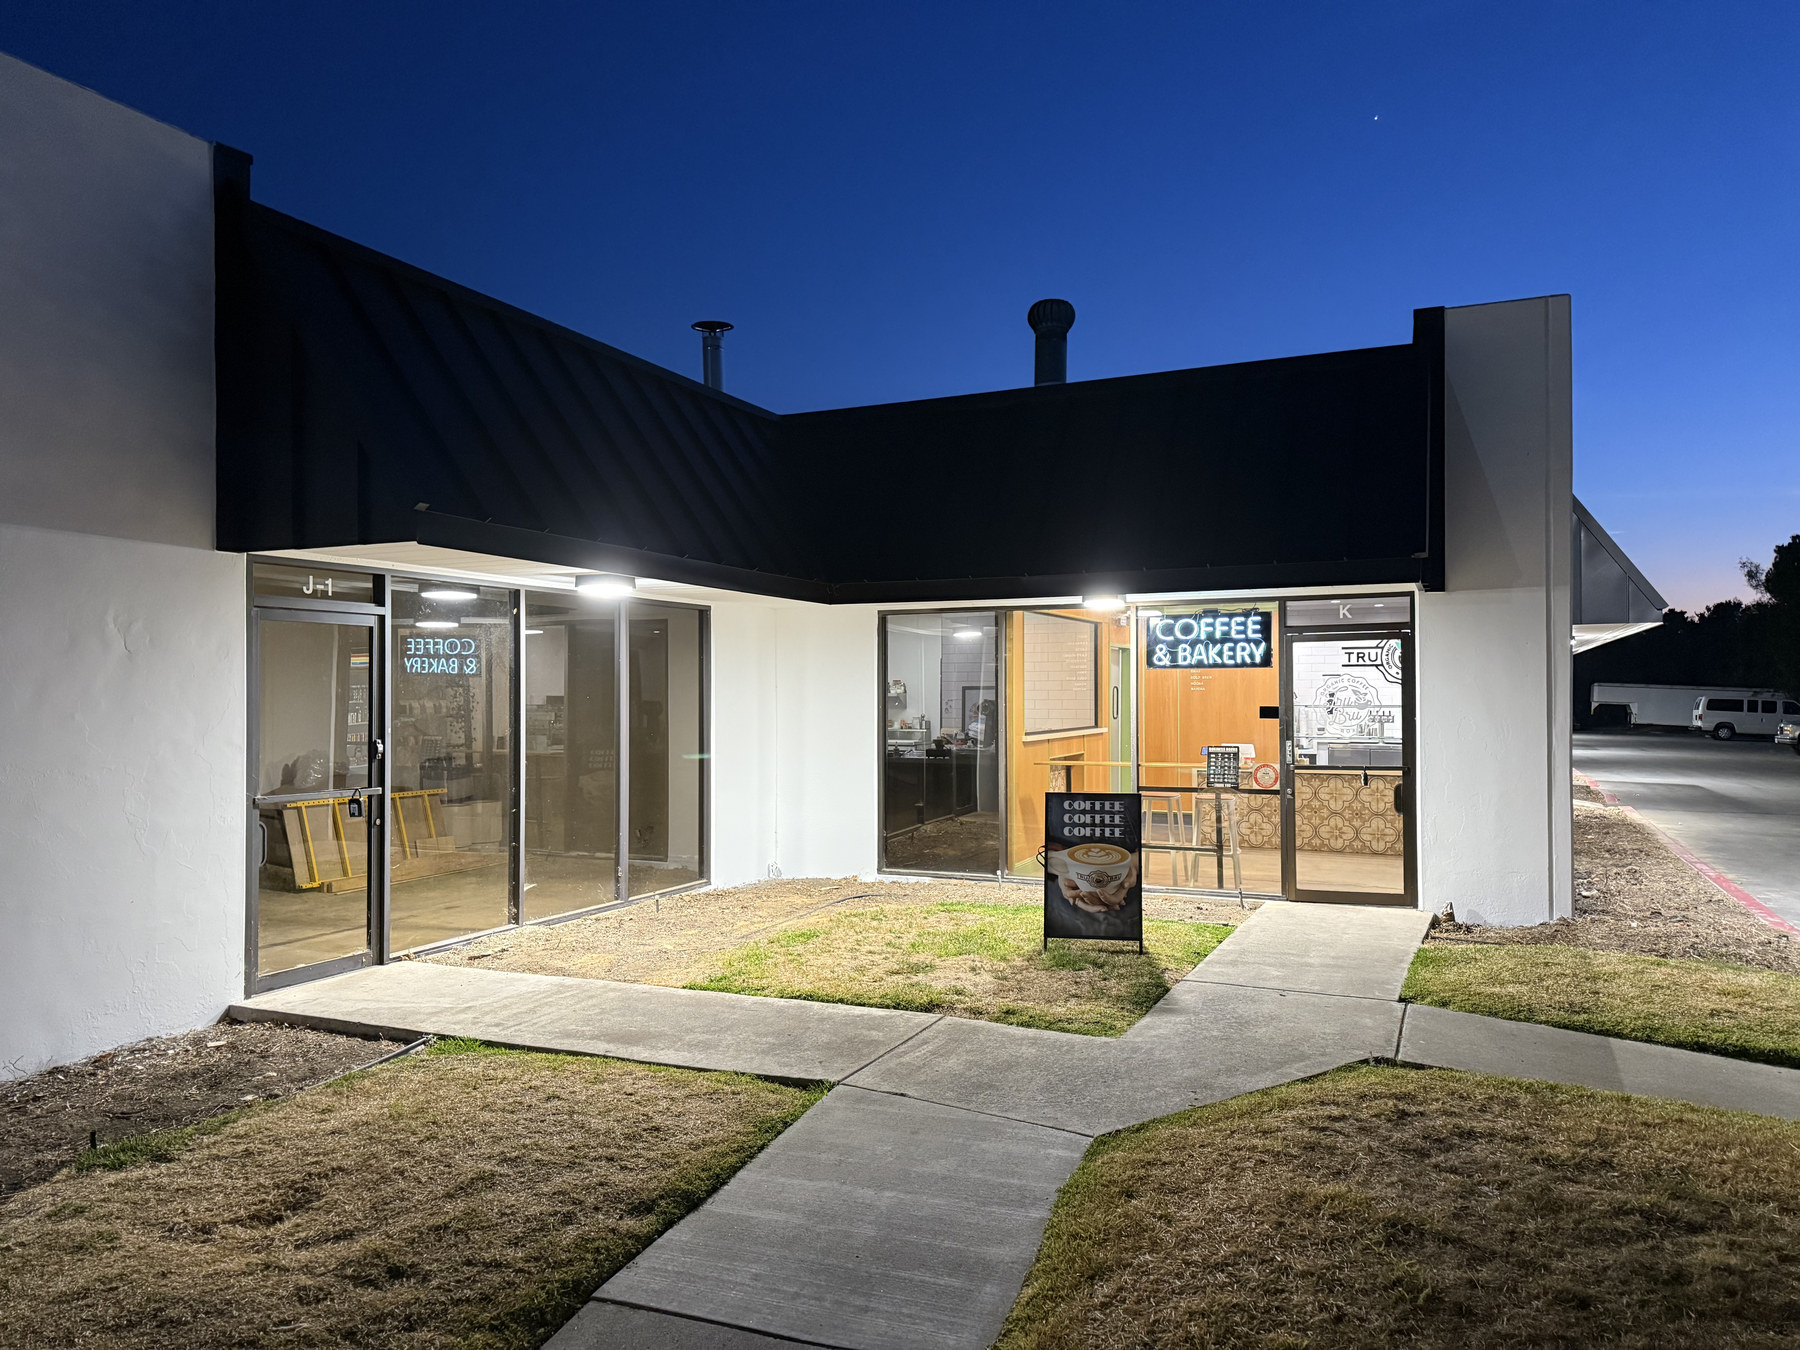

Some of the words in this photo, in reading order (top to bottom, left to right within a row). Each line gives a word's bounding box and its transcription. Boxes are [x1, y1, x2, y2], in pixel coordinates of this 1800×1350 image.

[303, 575, 332, 596] J-1
[1339, 604, 1352, 619] K
[1156, 616, 1262, 640] COFFEE
[1153, 643, 1171, 666] &
[1178, 642, 1265, 665] BAKERY
[1344, 651, 1378, 663] TRU
[1063, 800, 1124, 811] COFFEE
[1063, 813, 1124, 824] COFFEE
[1063, 826, 1124, 837] COFFEE
